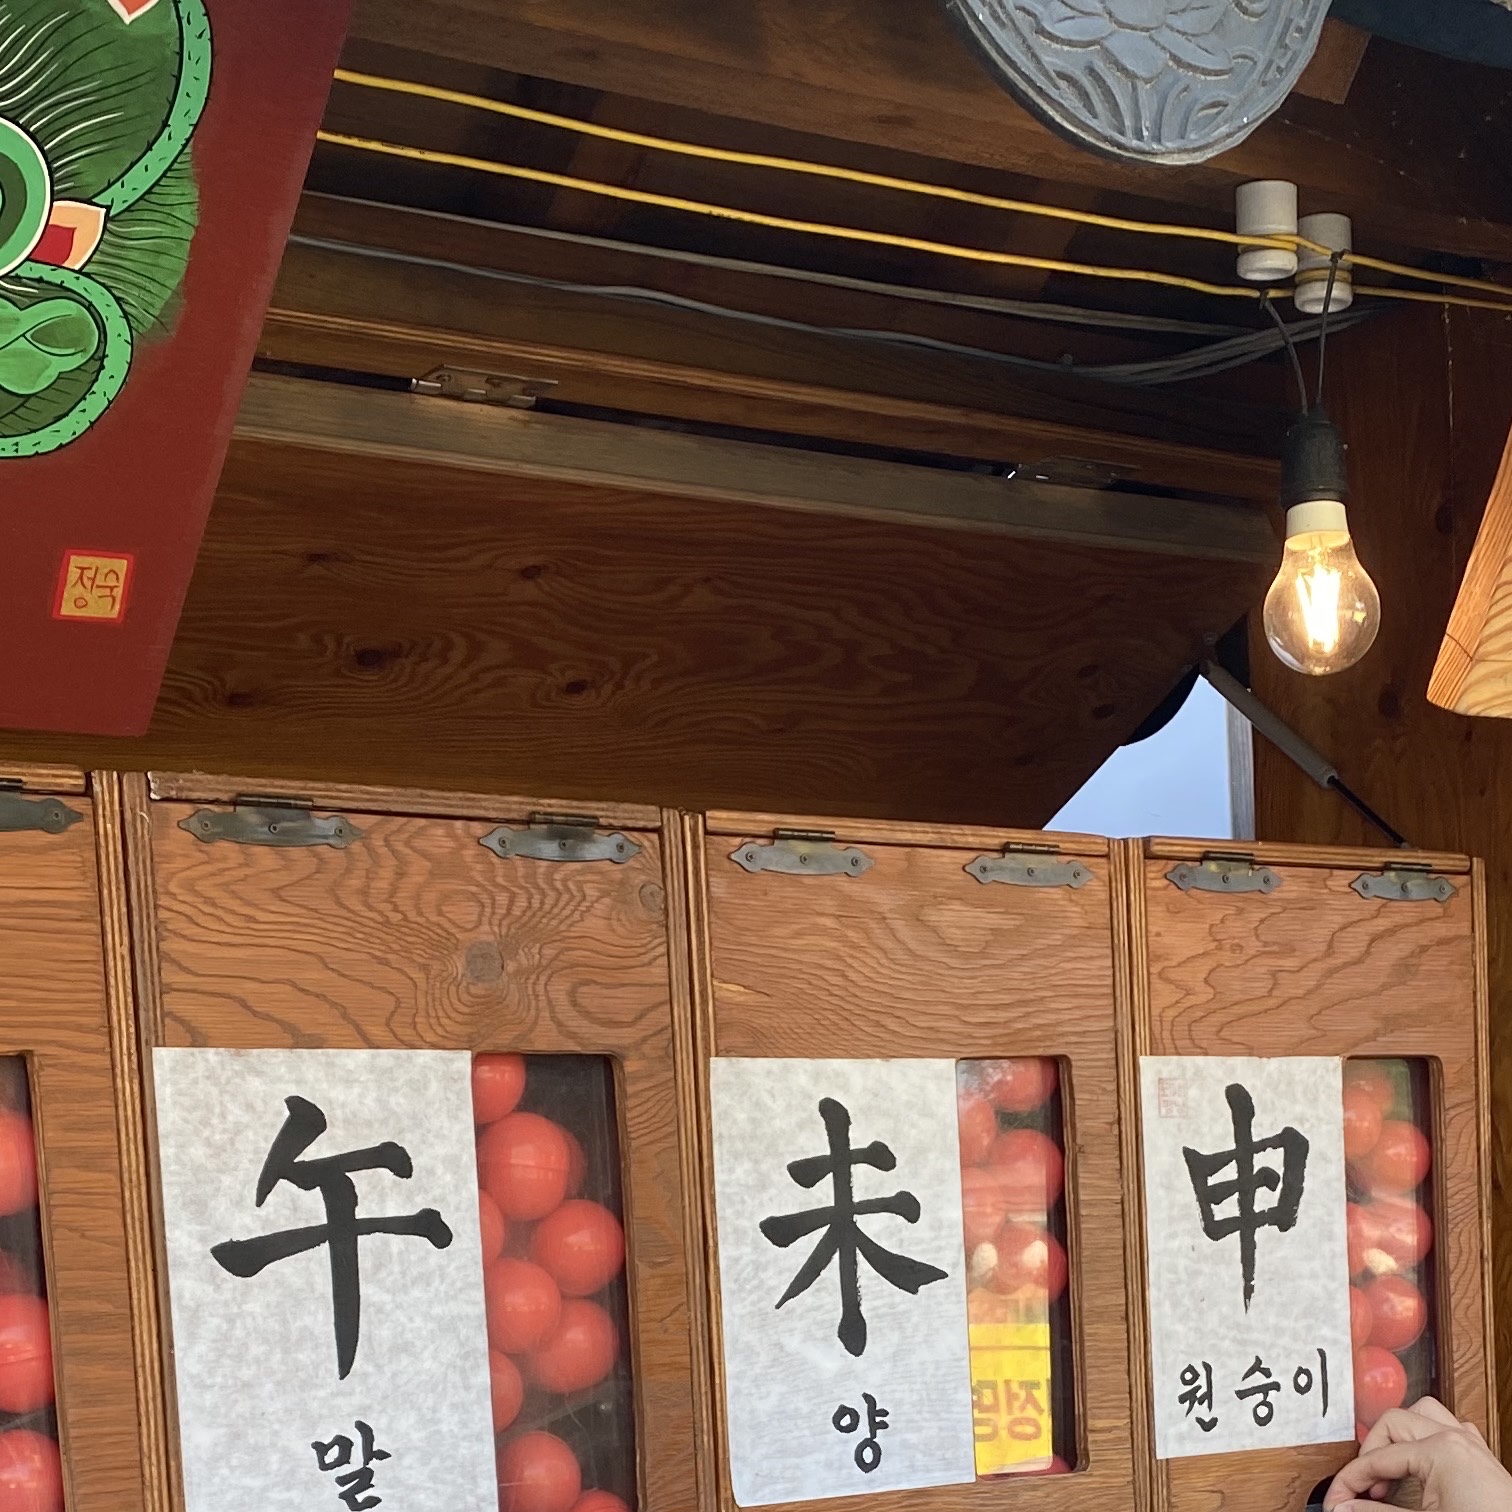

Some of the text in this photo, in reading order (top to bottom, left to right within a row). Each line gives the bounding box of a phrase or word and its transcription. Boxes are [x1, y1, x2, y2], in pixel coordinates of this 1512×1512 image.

[210, 1095, 453, 1380] 午
[759, 1097, 949, 1357] 未
[1183, 1082, 1310, 1314] 申
[311, 1420, 391, 1512] 말
[831, 1392, 889, 1473] 양
[1178, 1348, 1329, 1432] 원숭이
